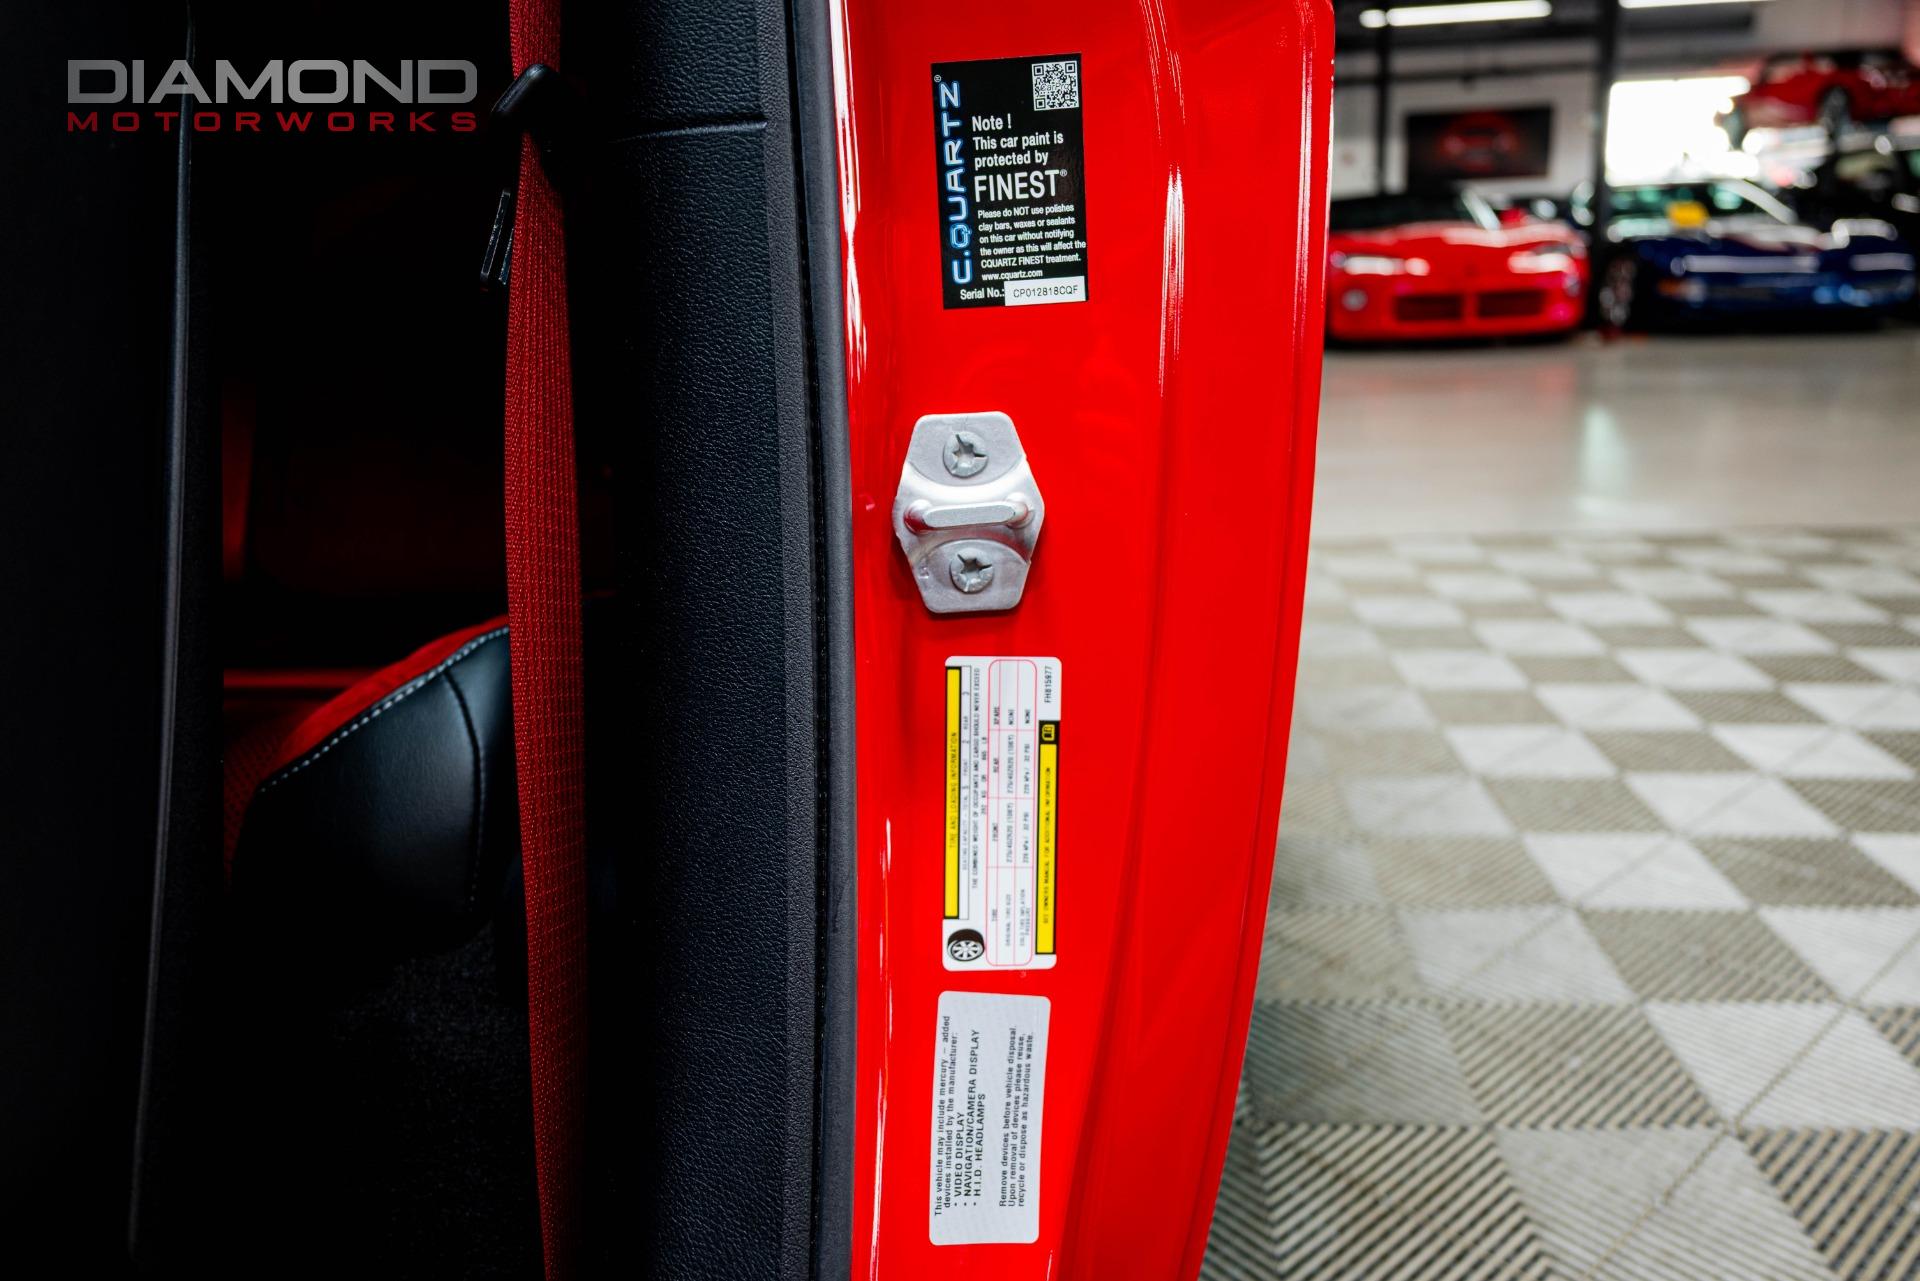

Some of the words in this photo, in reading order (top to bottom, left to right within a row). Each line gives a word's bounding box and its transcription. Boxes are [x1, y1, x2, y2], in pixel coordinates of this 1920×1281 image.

[972, 116, 1004, 132] Note
[972, 136, 997, 150] This
[1000, 136, 1018, 148] car
[1022, 132, 1050, 150] paint
[1054, 131, 1064, 144] is
[974, 150, 1031, 171] protected
[1035, 150, 1048, 165] by
[978, 208, 1001, 219] Please
[1002, 208, 1012, 216] do
[1014, 206, 1030, 216] NOT
[1031, 207, 1044, 215] use
[1045, 204, 1074, 215] polishes
[978, 222, 993, 232] clay
[994, 221, 1012, 230] bars,
[1014, 221, 1035, 229] waxes
[1037, 219, 1045, 227] or
[1046, 216, 1075, 226] sealants
[979, 236, 989, 244] on
[990, 233, 1003, 242] this
[1005, 233, 1016, 242] car
[1018, 230, 1044, 241] without
[1044, 229, 1074, 240] notifying
[980, 247, 992, 256] the
[993, 246, 1014, 255] owner
[1016, 245, 1024, 253] as
[1026, 243, 1039, 252] this
[1040, 242, 1052, 251] will
[1053, 241, 1073, 250] affect
[1074, 240, 1086, 249] the
[981, 258, 1017, 268] CQUARTZ
[1018, 255, 1045, 265] FINEST
[1045, 253, 1082, 263] treatment.
[982, 269, 1043, 281] www.cquartz.com
[960, 289, 985, 300] Serial
[1013, 285, 1078, 298] CP012818CQF
[942, 1016, 950, 1042] added
[969, 1029, 980, 1075] DISPLAY
[1007, 1025, 1016, 1064] disposal.
[1025, 1032, 1033, 1060] waste.
[939, 1059, 948, 1096] mercury
[948, 1032, 958, 1094] manufacturer:
[1014, 1063, 1022, 1091] please
[1005, 1067, 1013, 1098] vehicle
[1021, 1063, 1031, 1107] hazardous
[937, 1100, 945, 1133] include
[946, 1115, 954, 1126] by
[1002, 1102, 1011, 1129] before
[1012, 1095, 1020, 1128] devices
[1020, 1111, 1028, 1120] as
[955, 1112, 964, 1159] DISPLAY
[964, 1079, 976, 1197] NAVIGATION/CAMERA
[974, 1093, 986, 1161] HEADLAMPS
[1011, 1131, 1018, 1140] of
[1019, 1124, 1028, 1158] dispose
[937, 1136, 945, 1156] may
[944, 1130, 953, 1169] installed
[1001, 1132, 1009, 1166] devices
[1009, 1144, 1017, 1179] removal
[1019, 1161, 1025, 1171] or
[943, 1173, 951, 1208] devices
[954, 1163, 963, 1197] VIDEO
[974, 1165, 982, 1197] H.I.D.
[999, 1170, 1008, 1206] Remove
[1008, 1183, 1017, 1206] Upon
[1017, 1174, 1026, 1206] recycle
